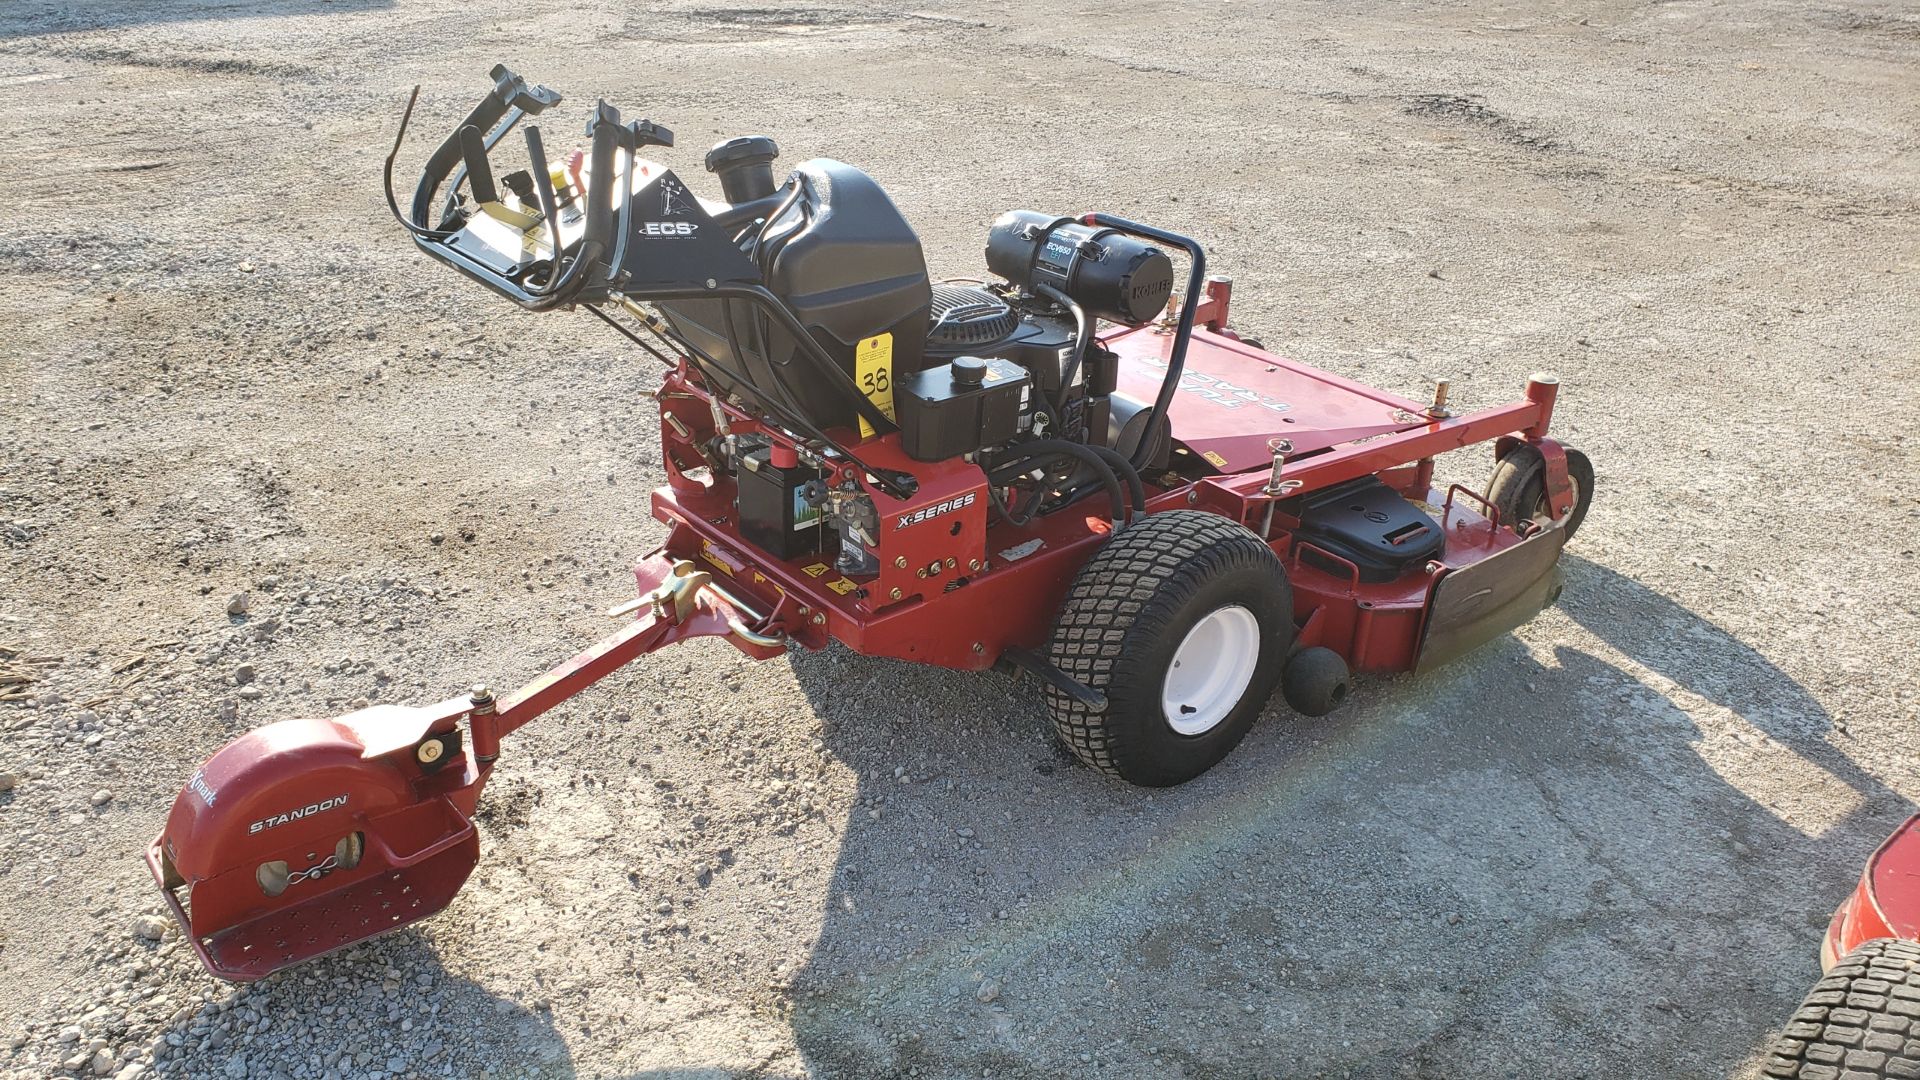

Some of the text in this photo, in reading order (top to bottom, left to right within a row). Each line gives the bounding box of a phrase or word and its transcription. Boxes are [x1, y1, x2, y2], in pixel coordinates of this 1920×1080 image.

[645, 222, 692, 235] ECS
[1046, 242, 1072, 256] ECV650
[1132, 280, 1170, 300] KOHLER
[863, 367, 889, 397] 38
[1140, 356, 1292, 413] TRACR
[897, 492, 976, 529] X-SERIES
[249, 794, 348, 834] STANDON
